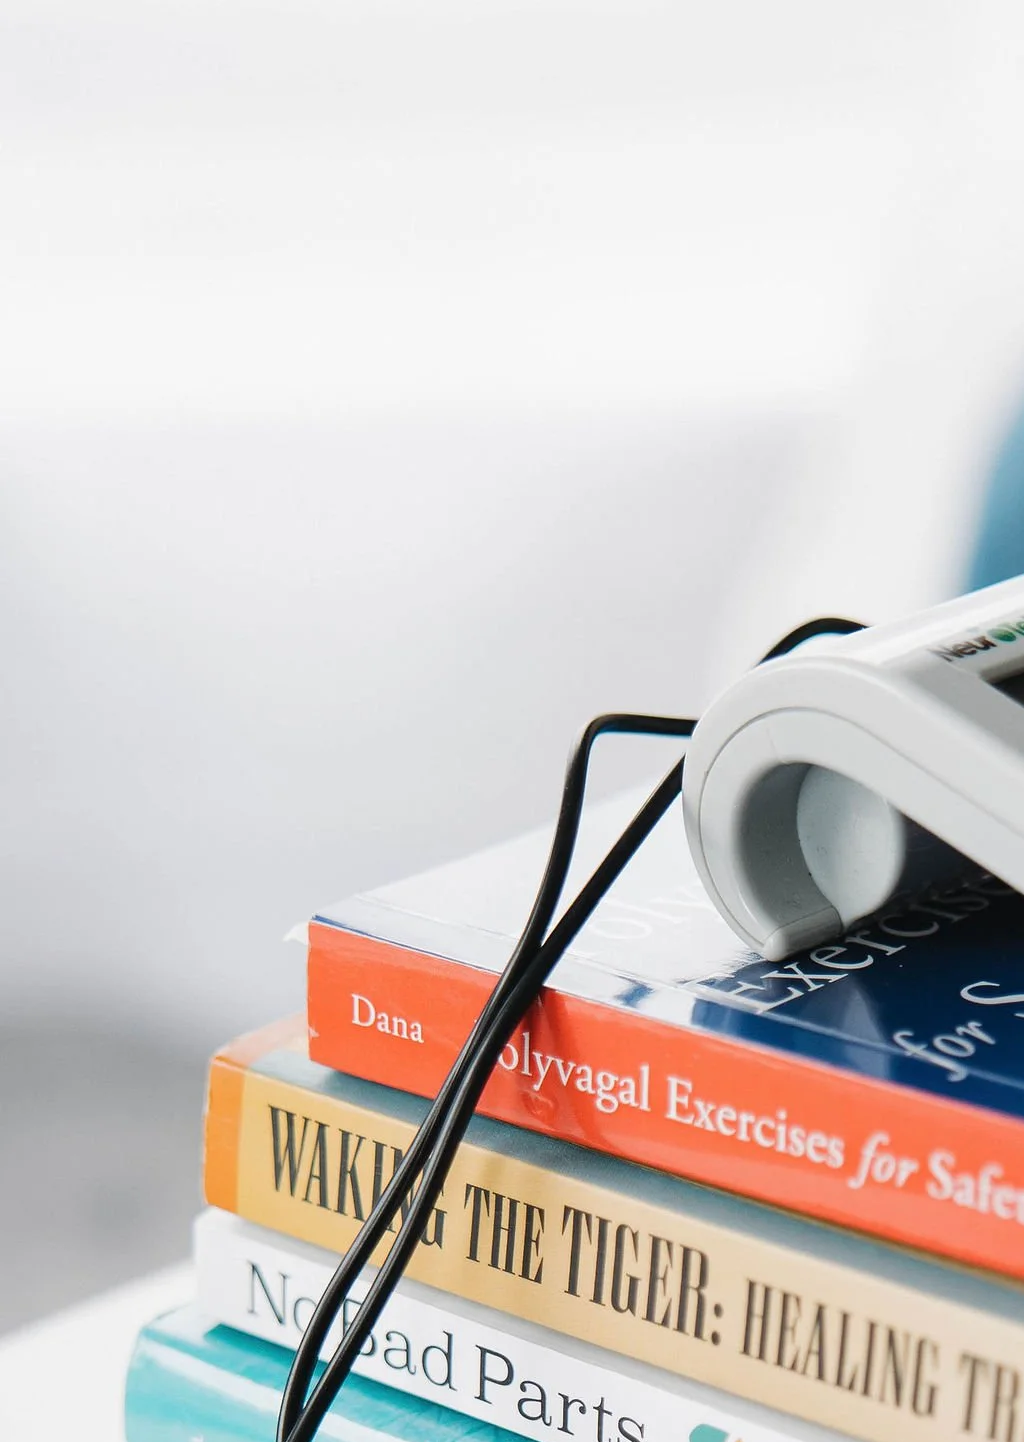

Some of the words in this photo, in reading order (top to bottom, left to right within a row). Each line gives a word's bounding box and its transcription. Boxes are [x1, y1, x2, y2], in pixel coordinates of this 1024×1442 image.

[351, 994, 425, 1043] Dana
[474, 1030, 651, 1114] olyvagal
[665, 1075, 846, 1169] Exercises
[849, 1132, 920, 1189] for
[894, 1020, 996, 1083] for
[246, 1260, 320, 1335] No
[340, 1296, 455, 1392] Bad
[464, 1182, 545, 1285] THE
[561, 1205, 725, 1347] TIGER:
[738, 1277, 940, 1420] HEALING
